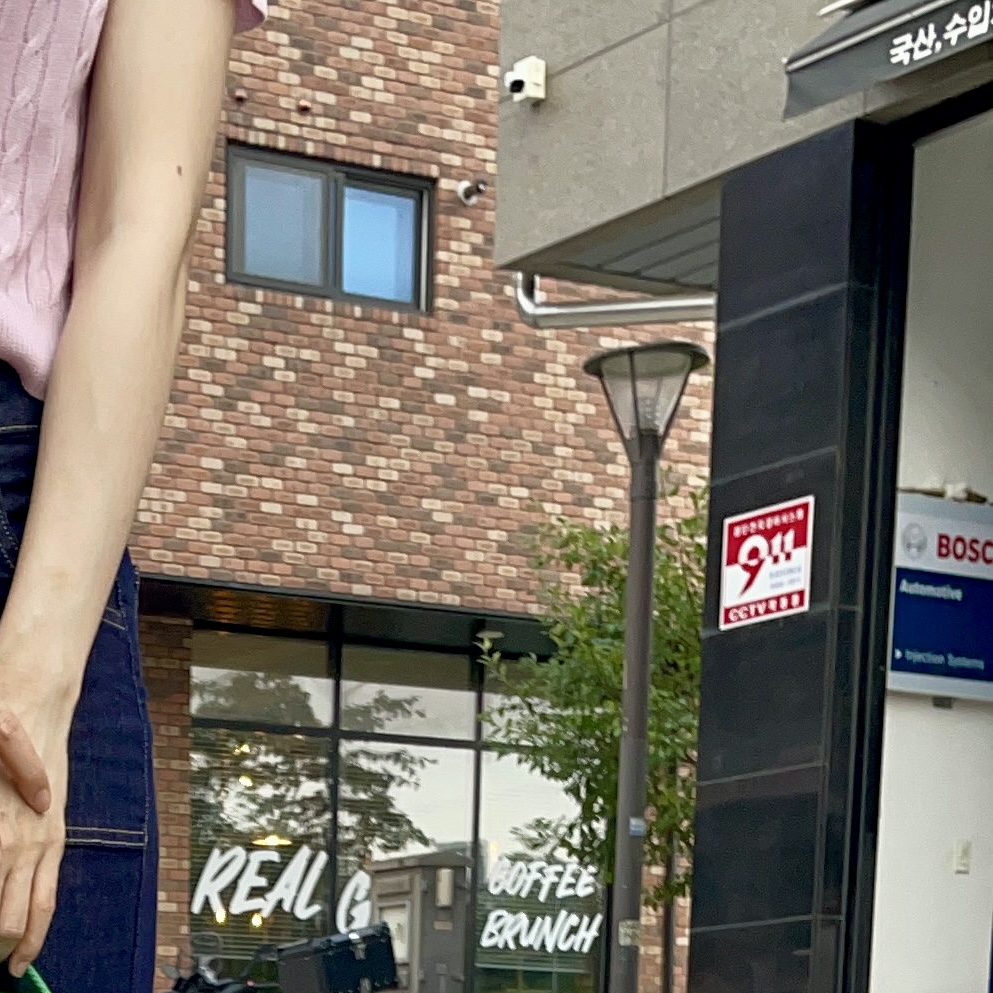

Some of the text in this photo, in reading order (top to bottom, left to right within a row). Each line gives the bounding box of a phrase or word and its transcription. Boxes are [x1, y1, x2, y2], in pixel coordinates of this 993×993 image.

[889, 0, 993, 65] 국산,수입
[899, 578, 963, 601] Automotive
[191, 844, 329, 920] REAL
[487, 856, 598, 902] COFFEE
[479, 909, 604, 953] BRUNCH
